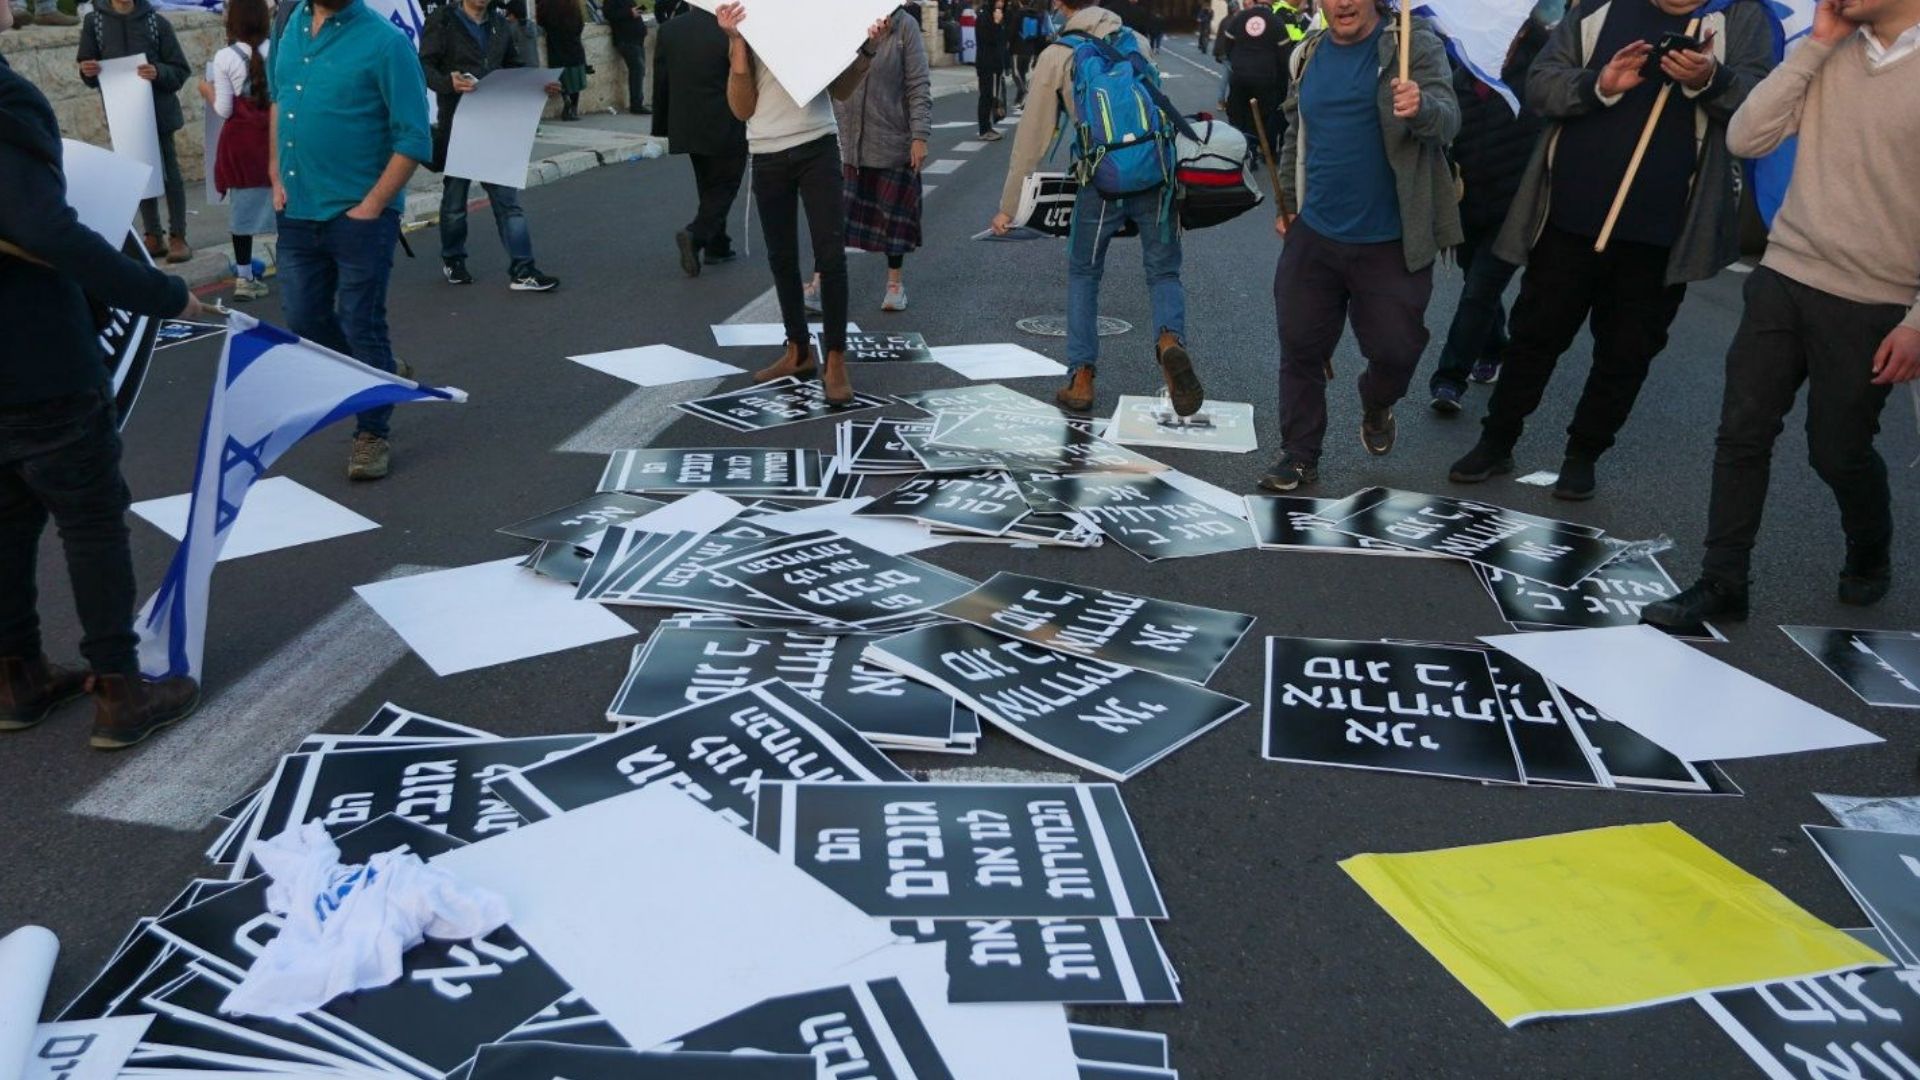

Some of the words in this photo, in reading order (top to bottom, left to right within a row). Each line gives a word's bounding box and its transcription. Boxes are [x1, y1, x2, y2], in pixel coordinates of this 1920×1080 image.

[934, 496, 1007, 514] סוג
[1083, 486, 1151, 501] אני
[561, 505, 636, 526] אני
[1078, 502, 1217, 523] אזרחית
[1385, 517, 1445, 540] סוג
[1119, 526, 1171, 545] ב'
[1168, 520, 1236, 540] סוג
[737, 542, 853, 575] הבחירות
[797, 569, 921, 606] גונבים
[871, 592, 923, 610] הם
[1021, 588, 1085, 606] ב'
[990, 603, 1057, 632] סוג
[1046, 590, 1148, 655] אזרחית
[702, 637, 771, 657] ב'
[1130, 623, 1199, 653] אני
[940, 647, 1020, 680] סוג
[999, 640, 1068, 665] ב'
[1303, 656, 1391, 683] סוג
[1414, 663, 1468, 692] ב'
[980, 662, 1136, 722] אזרחית
[1282, 682, 1496, 722] אזרחית
[1078, 697, 1169, 734] אני
[1344, 717, 1440, 751] אני
[324, 791, 375, 826] הם
[956, 808, 1012, 840] לנו
[814, 828, 861, 863] הם
[883, 801, 950, 899] גונבים
[1026, 799, 1096, 900] הבחירות
[972, 846, 1023, 888] את
